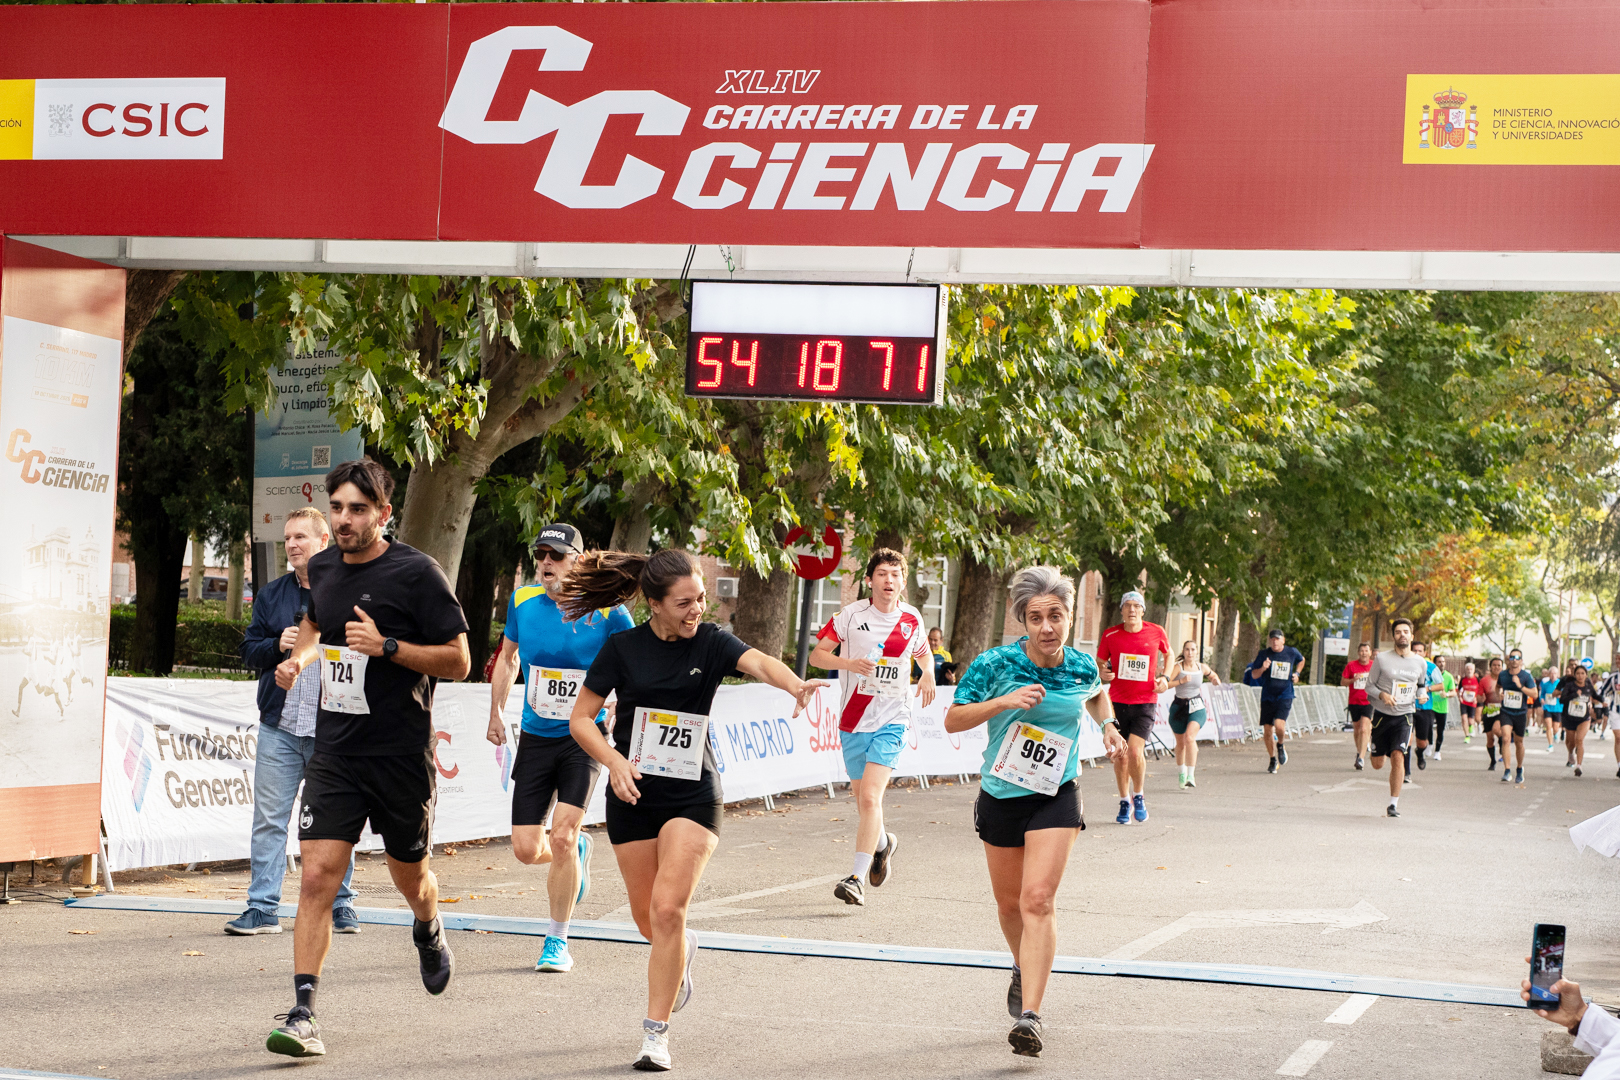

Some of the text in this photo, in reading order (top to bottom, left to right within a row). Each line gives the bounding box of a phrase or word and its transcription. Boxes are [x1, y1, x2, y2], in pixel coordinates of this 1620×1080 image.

[715, 69, 822, 94] XLIV
[82, 102, 210, 138] CSIC
[703, 104, 1038, 130] CARRERA DE LA
[1493, 108, 1553, 117] MINISTERIO
[1492, 120, 1507, 129] DE
[1509, 120, 1555, 130] CIENCIA,
[1492, 131, 1584, 140] Y UNIVERSIDADES
[698, 336, 758, 389] 54
[798, 341, 841, 392] 18
[282, 401, 289, 413] y
[47, 456, 96, 469] CARRERA DE LA
[540, 530, 566, 541] HOKA
[344, 653, 362, 661] CSIC
[330, 661, 353, 684] 724
[875, 665, 898, 680] 1778
[1127, 660, 1146, 670] 1896
[547, 679, 577, 698] 862
[683, 719, 702, 727] CSIC
[658, 724, 692, 749] 725
[725, 717, 794, 763] MADRID
[1048, 738, 1066, 749] CSIC
[1020, 738, 1058, 768] 962
[164, 769, 254, 809] General
